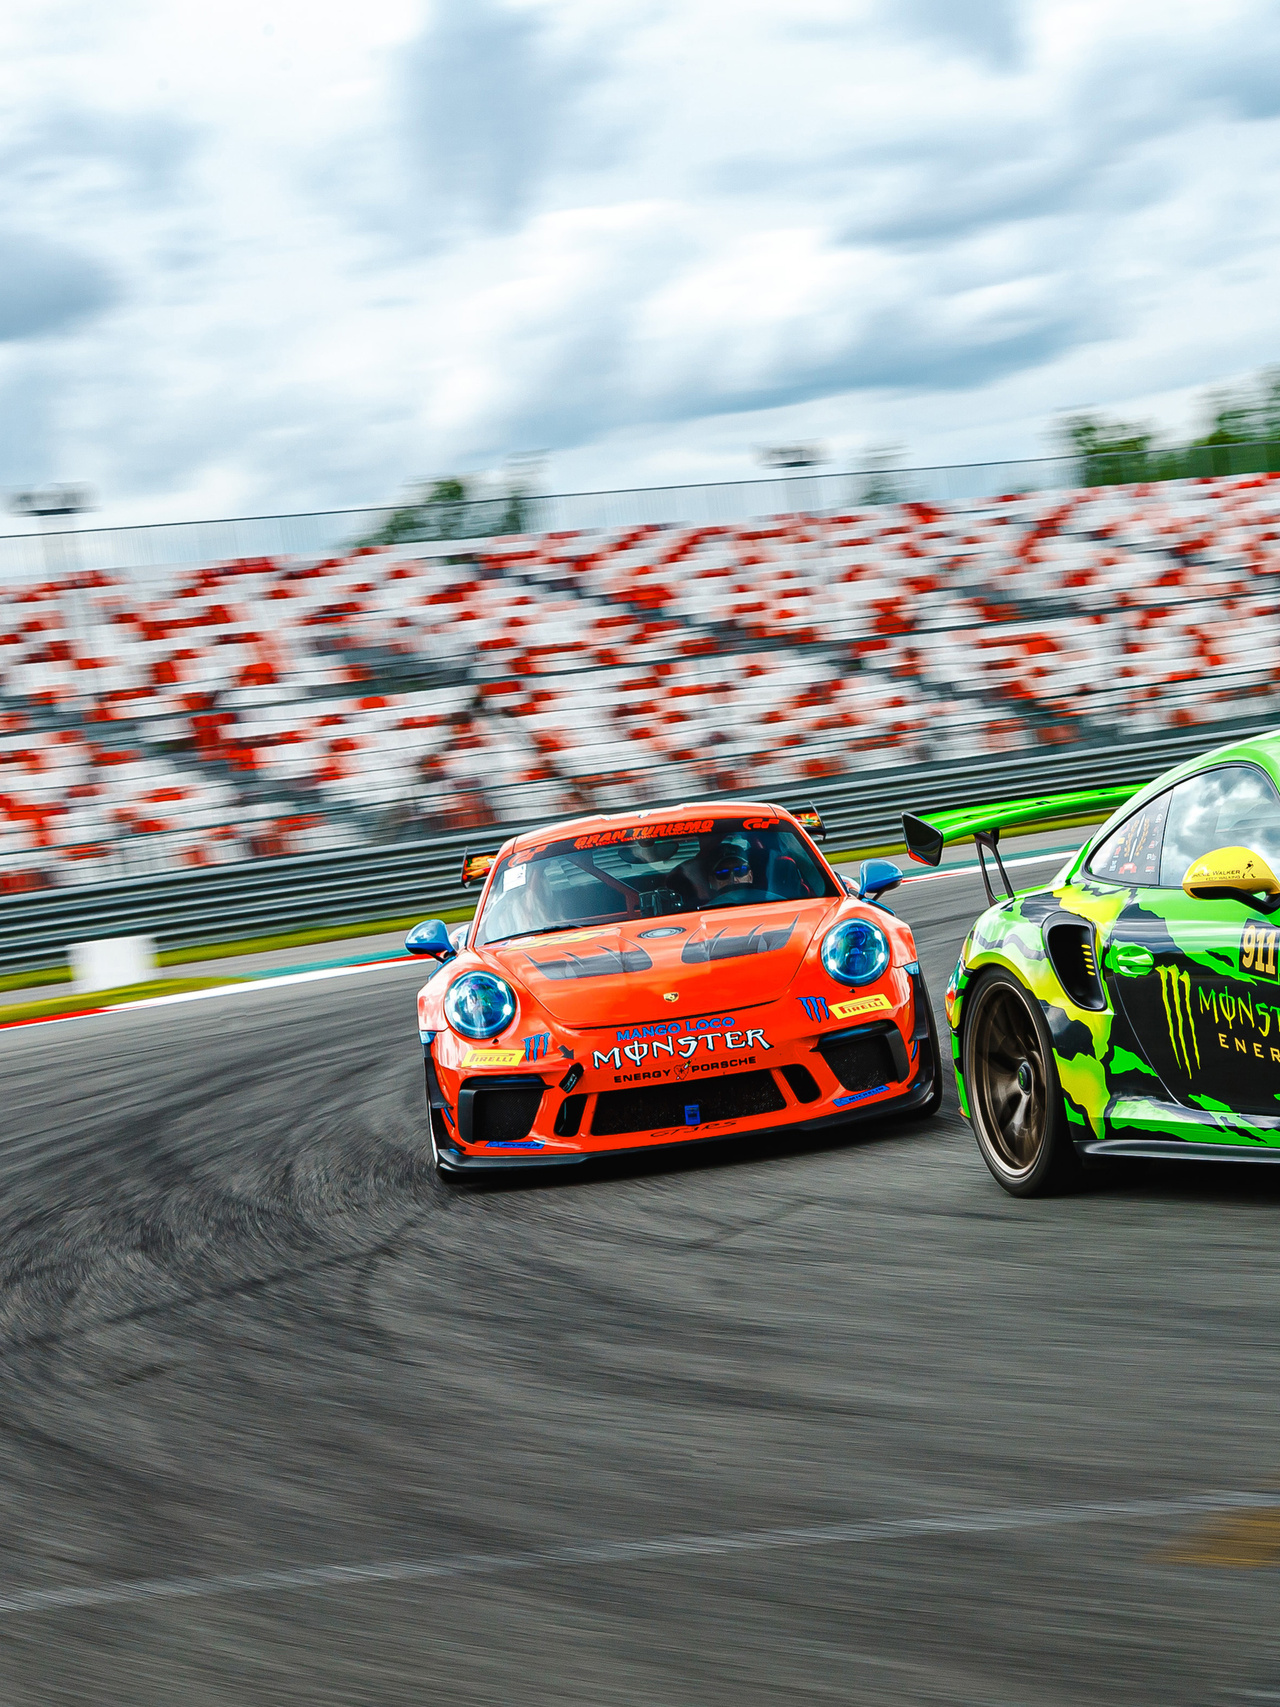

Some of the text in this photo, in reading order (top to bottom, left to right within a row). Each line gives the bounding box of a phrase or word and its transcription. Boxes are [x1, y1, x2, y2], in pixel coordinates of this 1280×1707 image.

[574, 819, 714, 847] GRAN TURISMO
[1241, 924, 1277, 976] 911
[837, 997, 885, 1015] PIRELLI
[616, 1017, 735, 1041] MANGO LOCO
[469, 1052, 516, 1063] PIRELLI
[592, 1028, 775, 1070] MONSTER
[613, 1056, 757, 1083] ENERGY PORSCHE
[848, 1086, 885, 1102] MICHELIN
